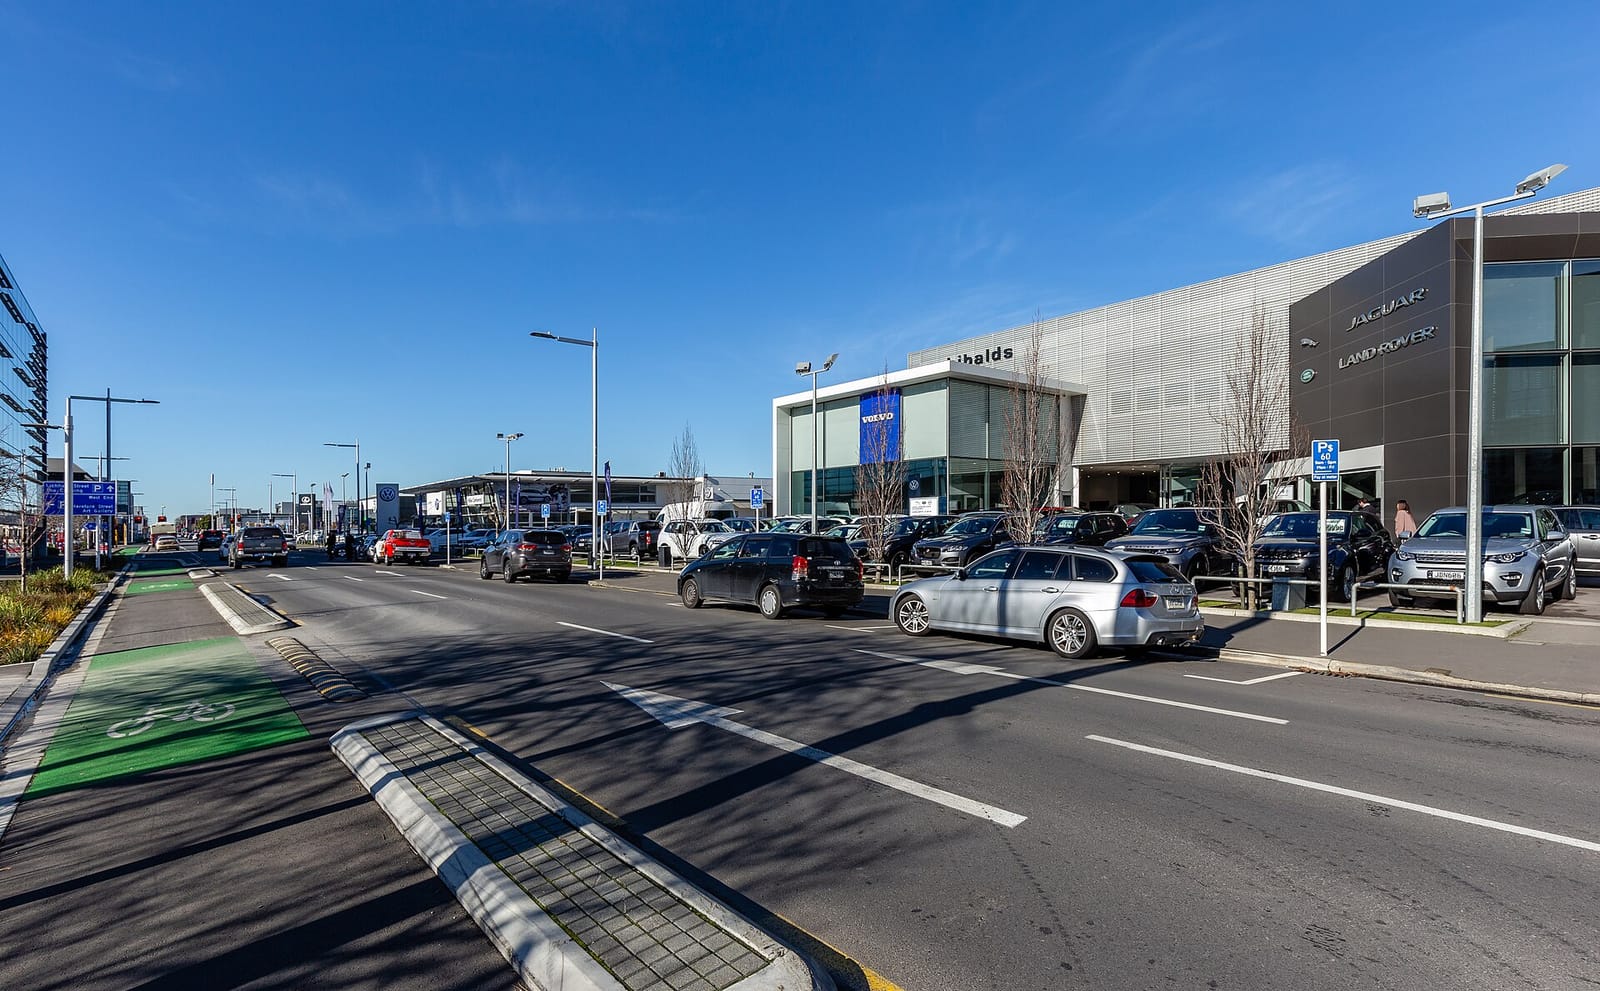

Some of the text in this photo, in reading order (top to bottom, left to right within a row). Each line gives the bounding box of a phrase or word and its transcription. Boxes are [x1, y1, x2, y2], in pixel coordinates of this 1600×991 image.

[1346, 287, 1425, 331] JAGUAR
[947, 346, 1013, 365] ibalds
[862, 412, 894, 423] VOLVO
